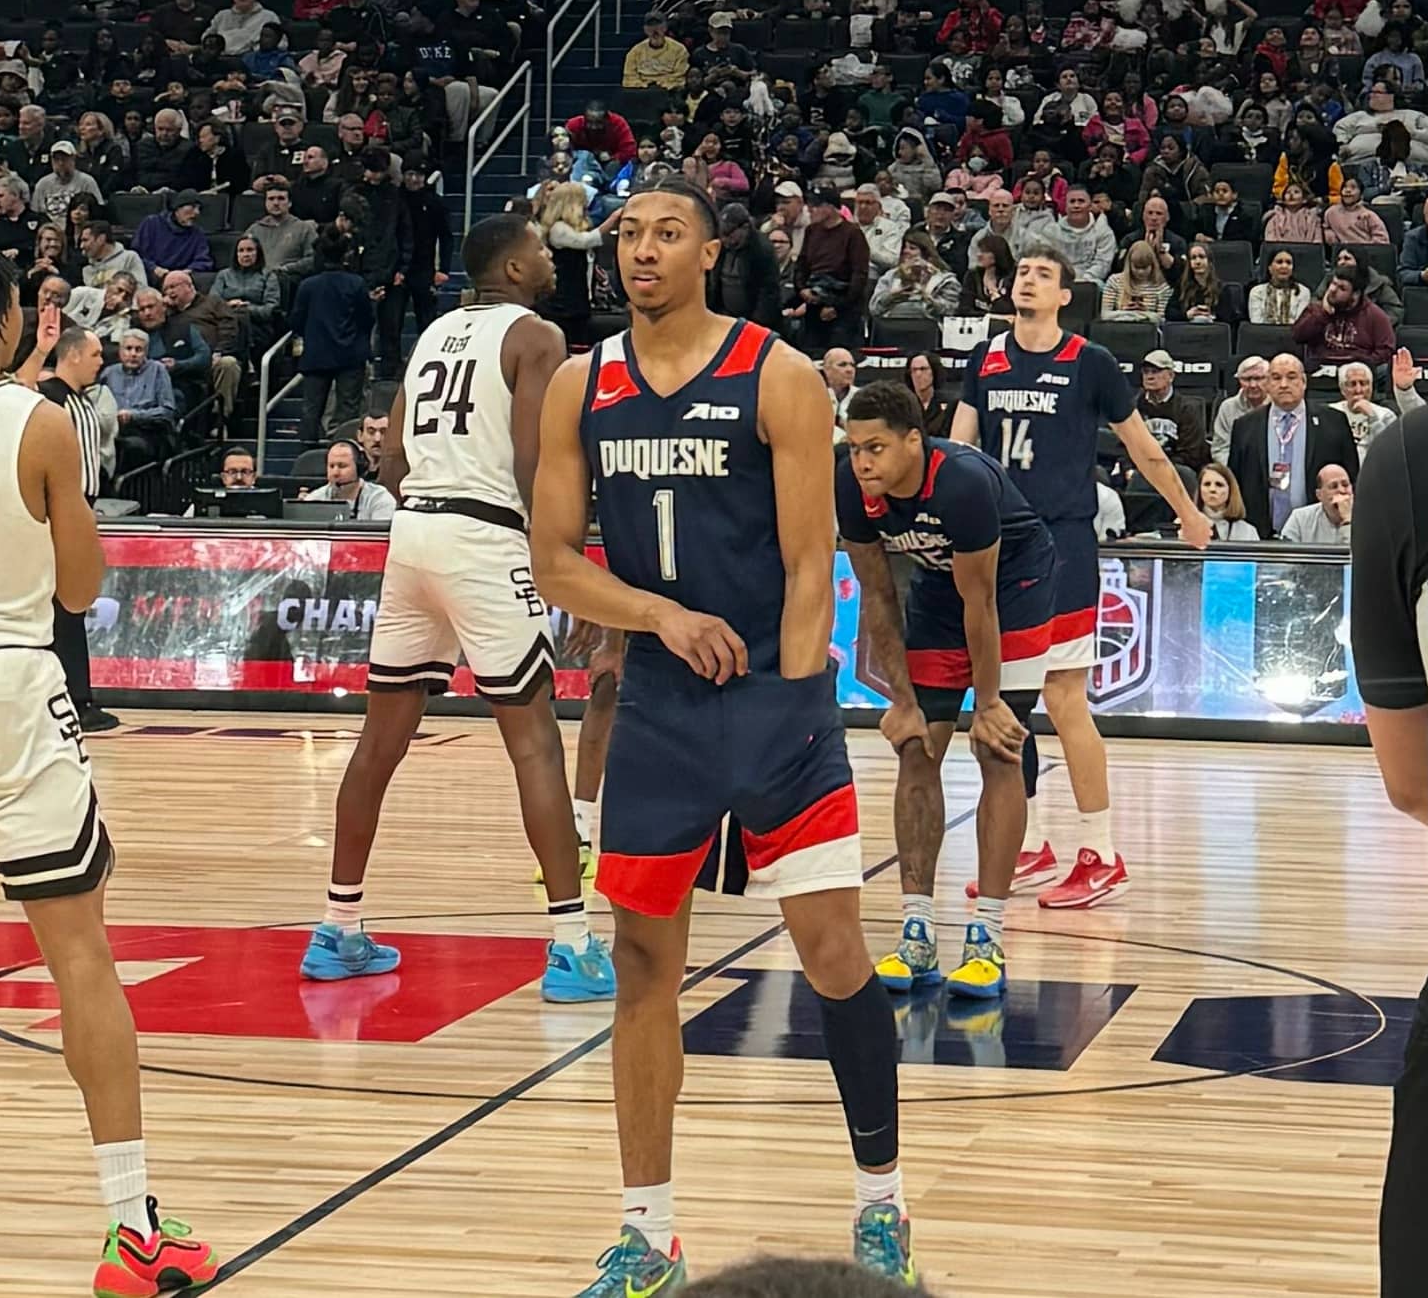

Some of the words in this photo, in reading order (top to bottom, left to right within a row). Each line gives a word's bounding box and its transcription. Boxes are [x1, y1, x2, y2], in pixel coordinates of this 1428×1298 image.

[413, 359, 477, 437] 24
[682, 403, 740, 421] A10
[988, 389, 1059, 415] DUQUESNE
[599, 438, 730, 480] DUQUESNE
[1001, 418, 1035, 471] 14
[653, 489, 677, 581] 1
